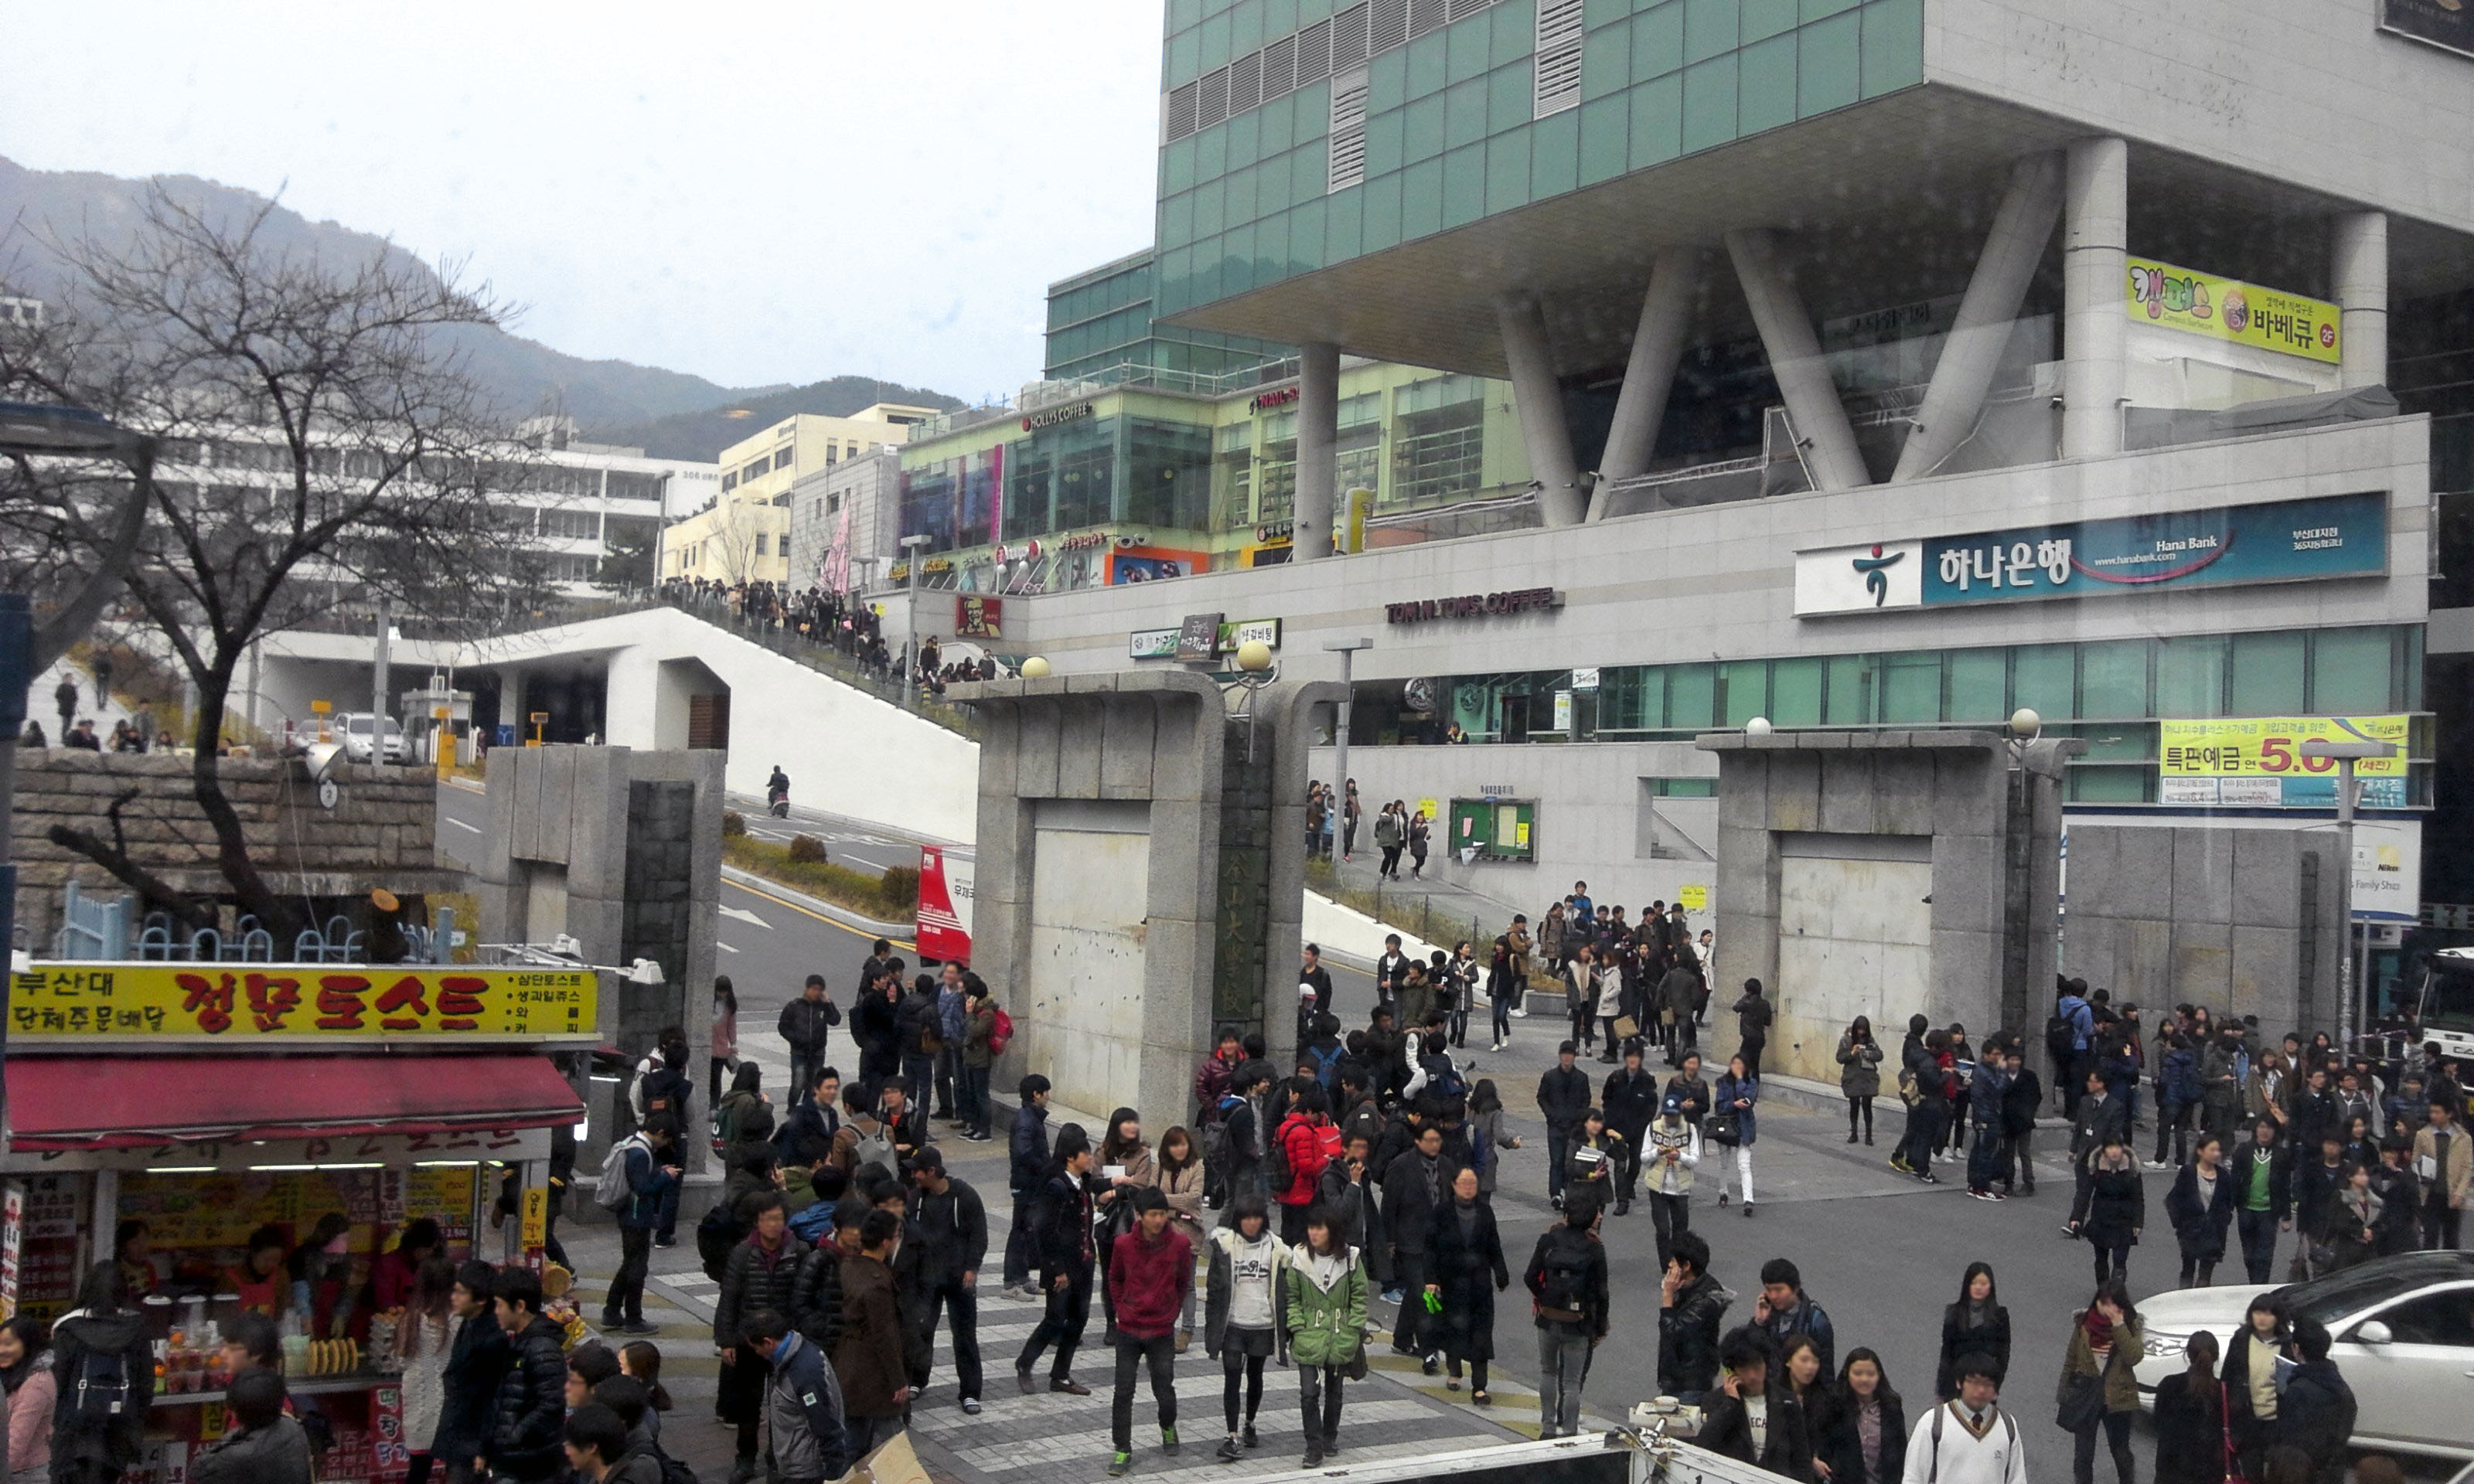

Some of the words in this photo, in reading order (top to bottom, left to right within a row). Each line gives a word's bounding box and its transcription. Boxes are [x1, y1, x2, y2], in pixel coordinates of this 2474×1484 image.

[2254, 309, 2313, 349] 바베큐
[2322, 330, 2333, 343] 2F
[1058, 403, 1089, 422] COFFEE
[2156, 539, 2186, 552] Hana
[2188, 535, 2217, 550] Bank
[2292, 526, 2339, 539] 부산대지점
[1940, 539, 2071, 591] 하나은행
[2094, 552, 2176, 567] www.hanabank.com
[1486, 587, 1553, 615] COFFEE
[2166, 747, 2241, 771] 특판예금
[16, 972, 114, 997] 부산대
[517, 975, 581, 987] 삼단토스트
[175, 972, 489, 1034] 정문토스트
[14, 1006, 166, 1032] 단체주문배달
